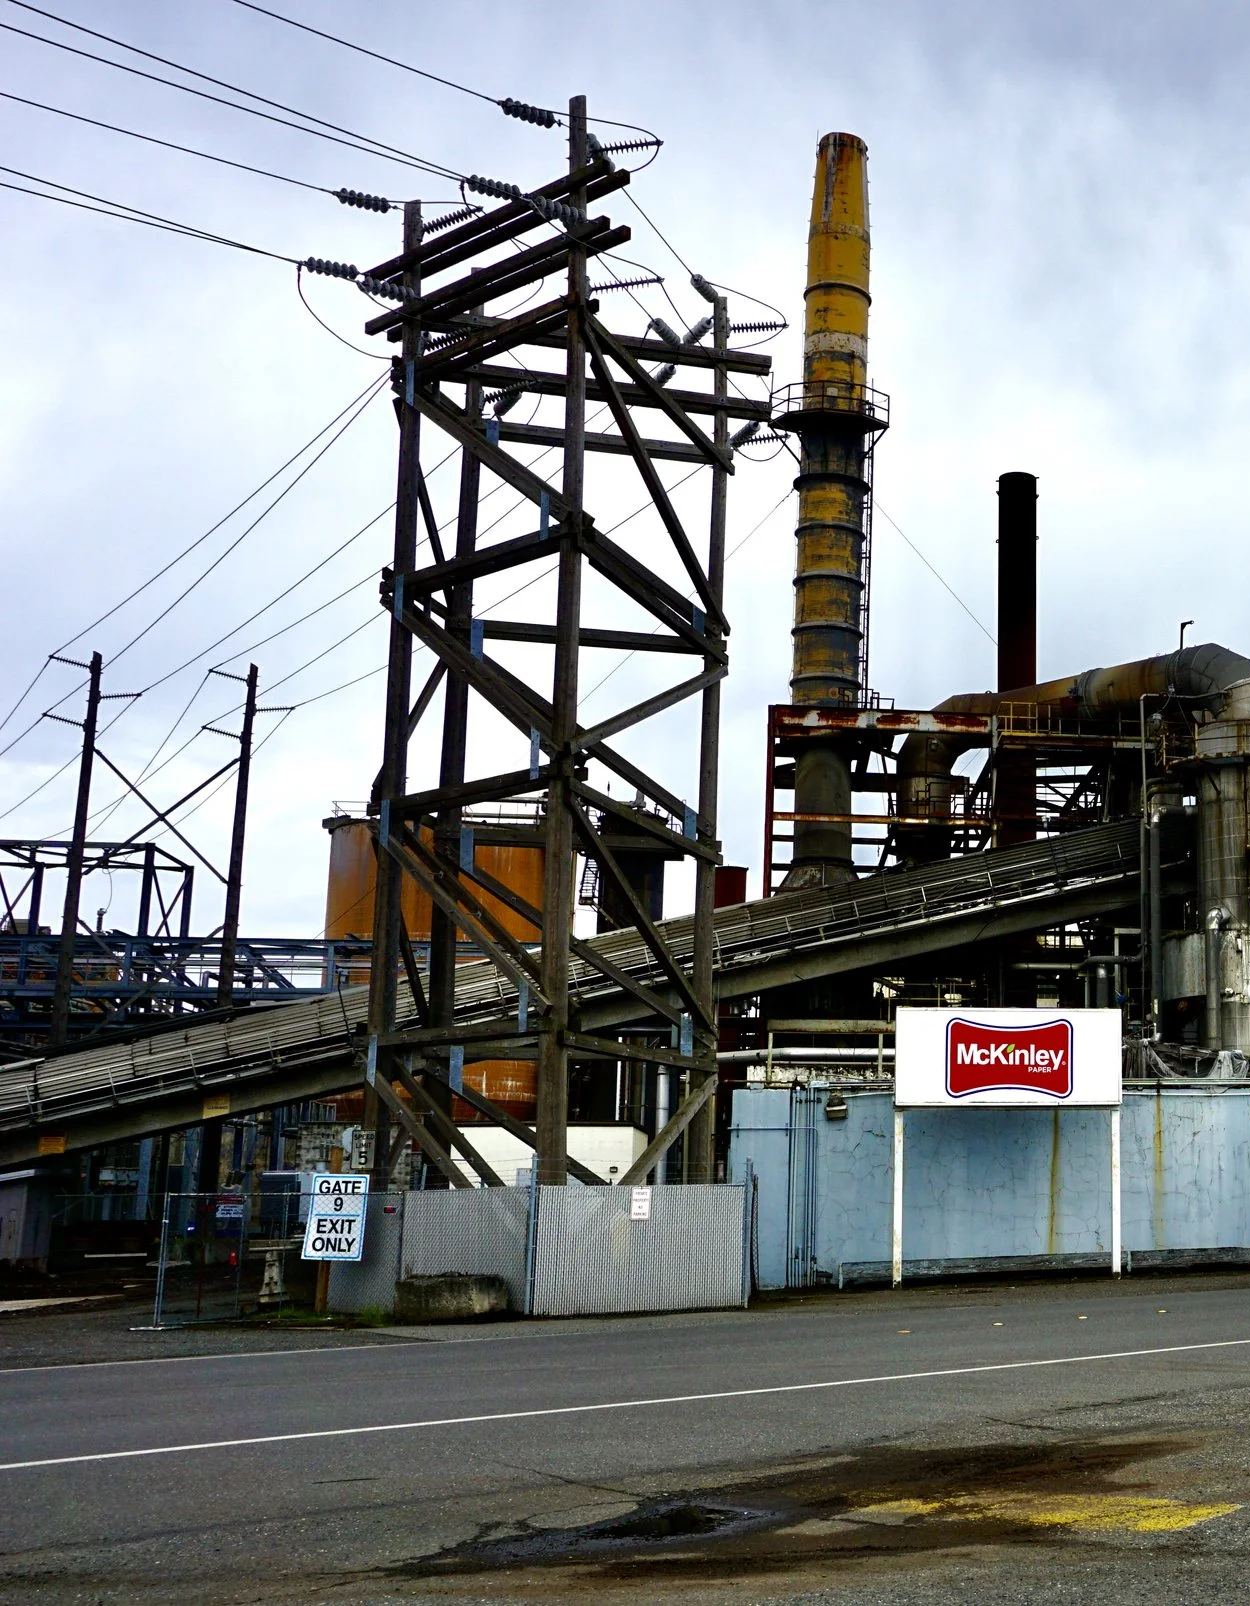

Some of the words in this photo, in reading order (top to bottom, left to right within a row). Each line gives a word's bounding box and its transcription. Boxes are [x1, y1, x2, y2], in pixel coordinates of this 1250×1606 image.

[957, 1043, 1065, 1071] McKinley
[358, 1151, 368, 1165] 5
[319, 1180, 362, 1194] GATE
[333, 1197, 344, 1212] 9
[316, 1218, 356, 1235] EXIT
[312, 1236, 356, 1252] ONLY
